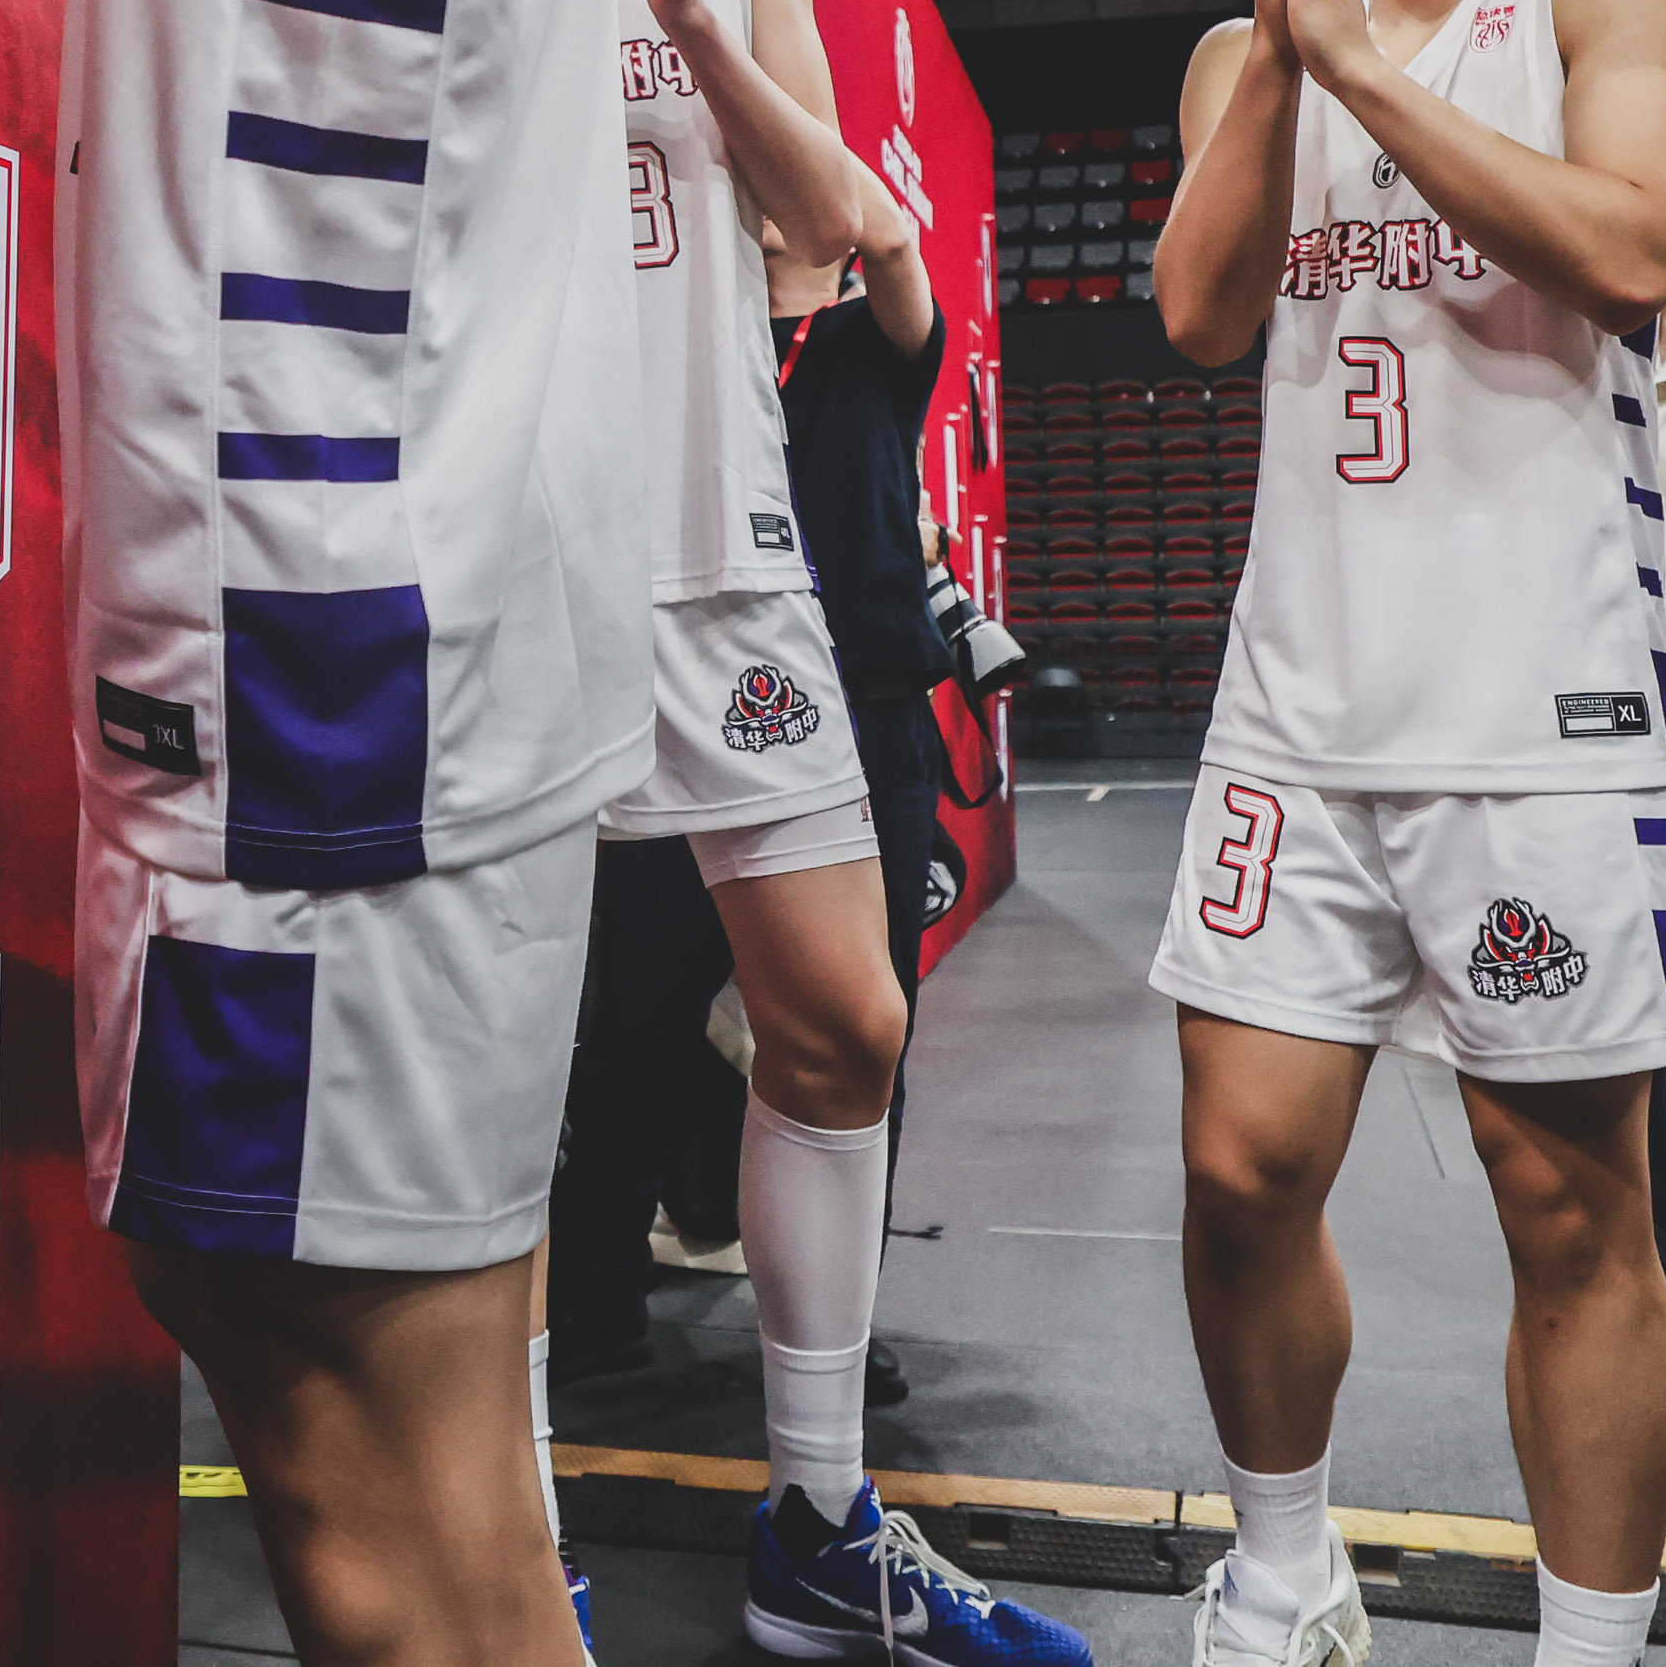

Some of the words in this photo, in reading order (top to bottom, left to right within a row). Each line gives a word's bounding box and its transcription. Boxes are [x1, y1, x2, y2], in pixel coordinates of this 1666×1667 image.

[1336, 336, 1410, 485] 3
[724, 707, 818, 752] 清华附中
[1617, 704, 1642, 723] XL
[1199, 782, 1284, 940] 3
[1471, 954, 1584, 1002] 清华附中
